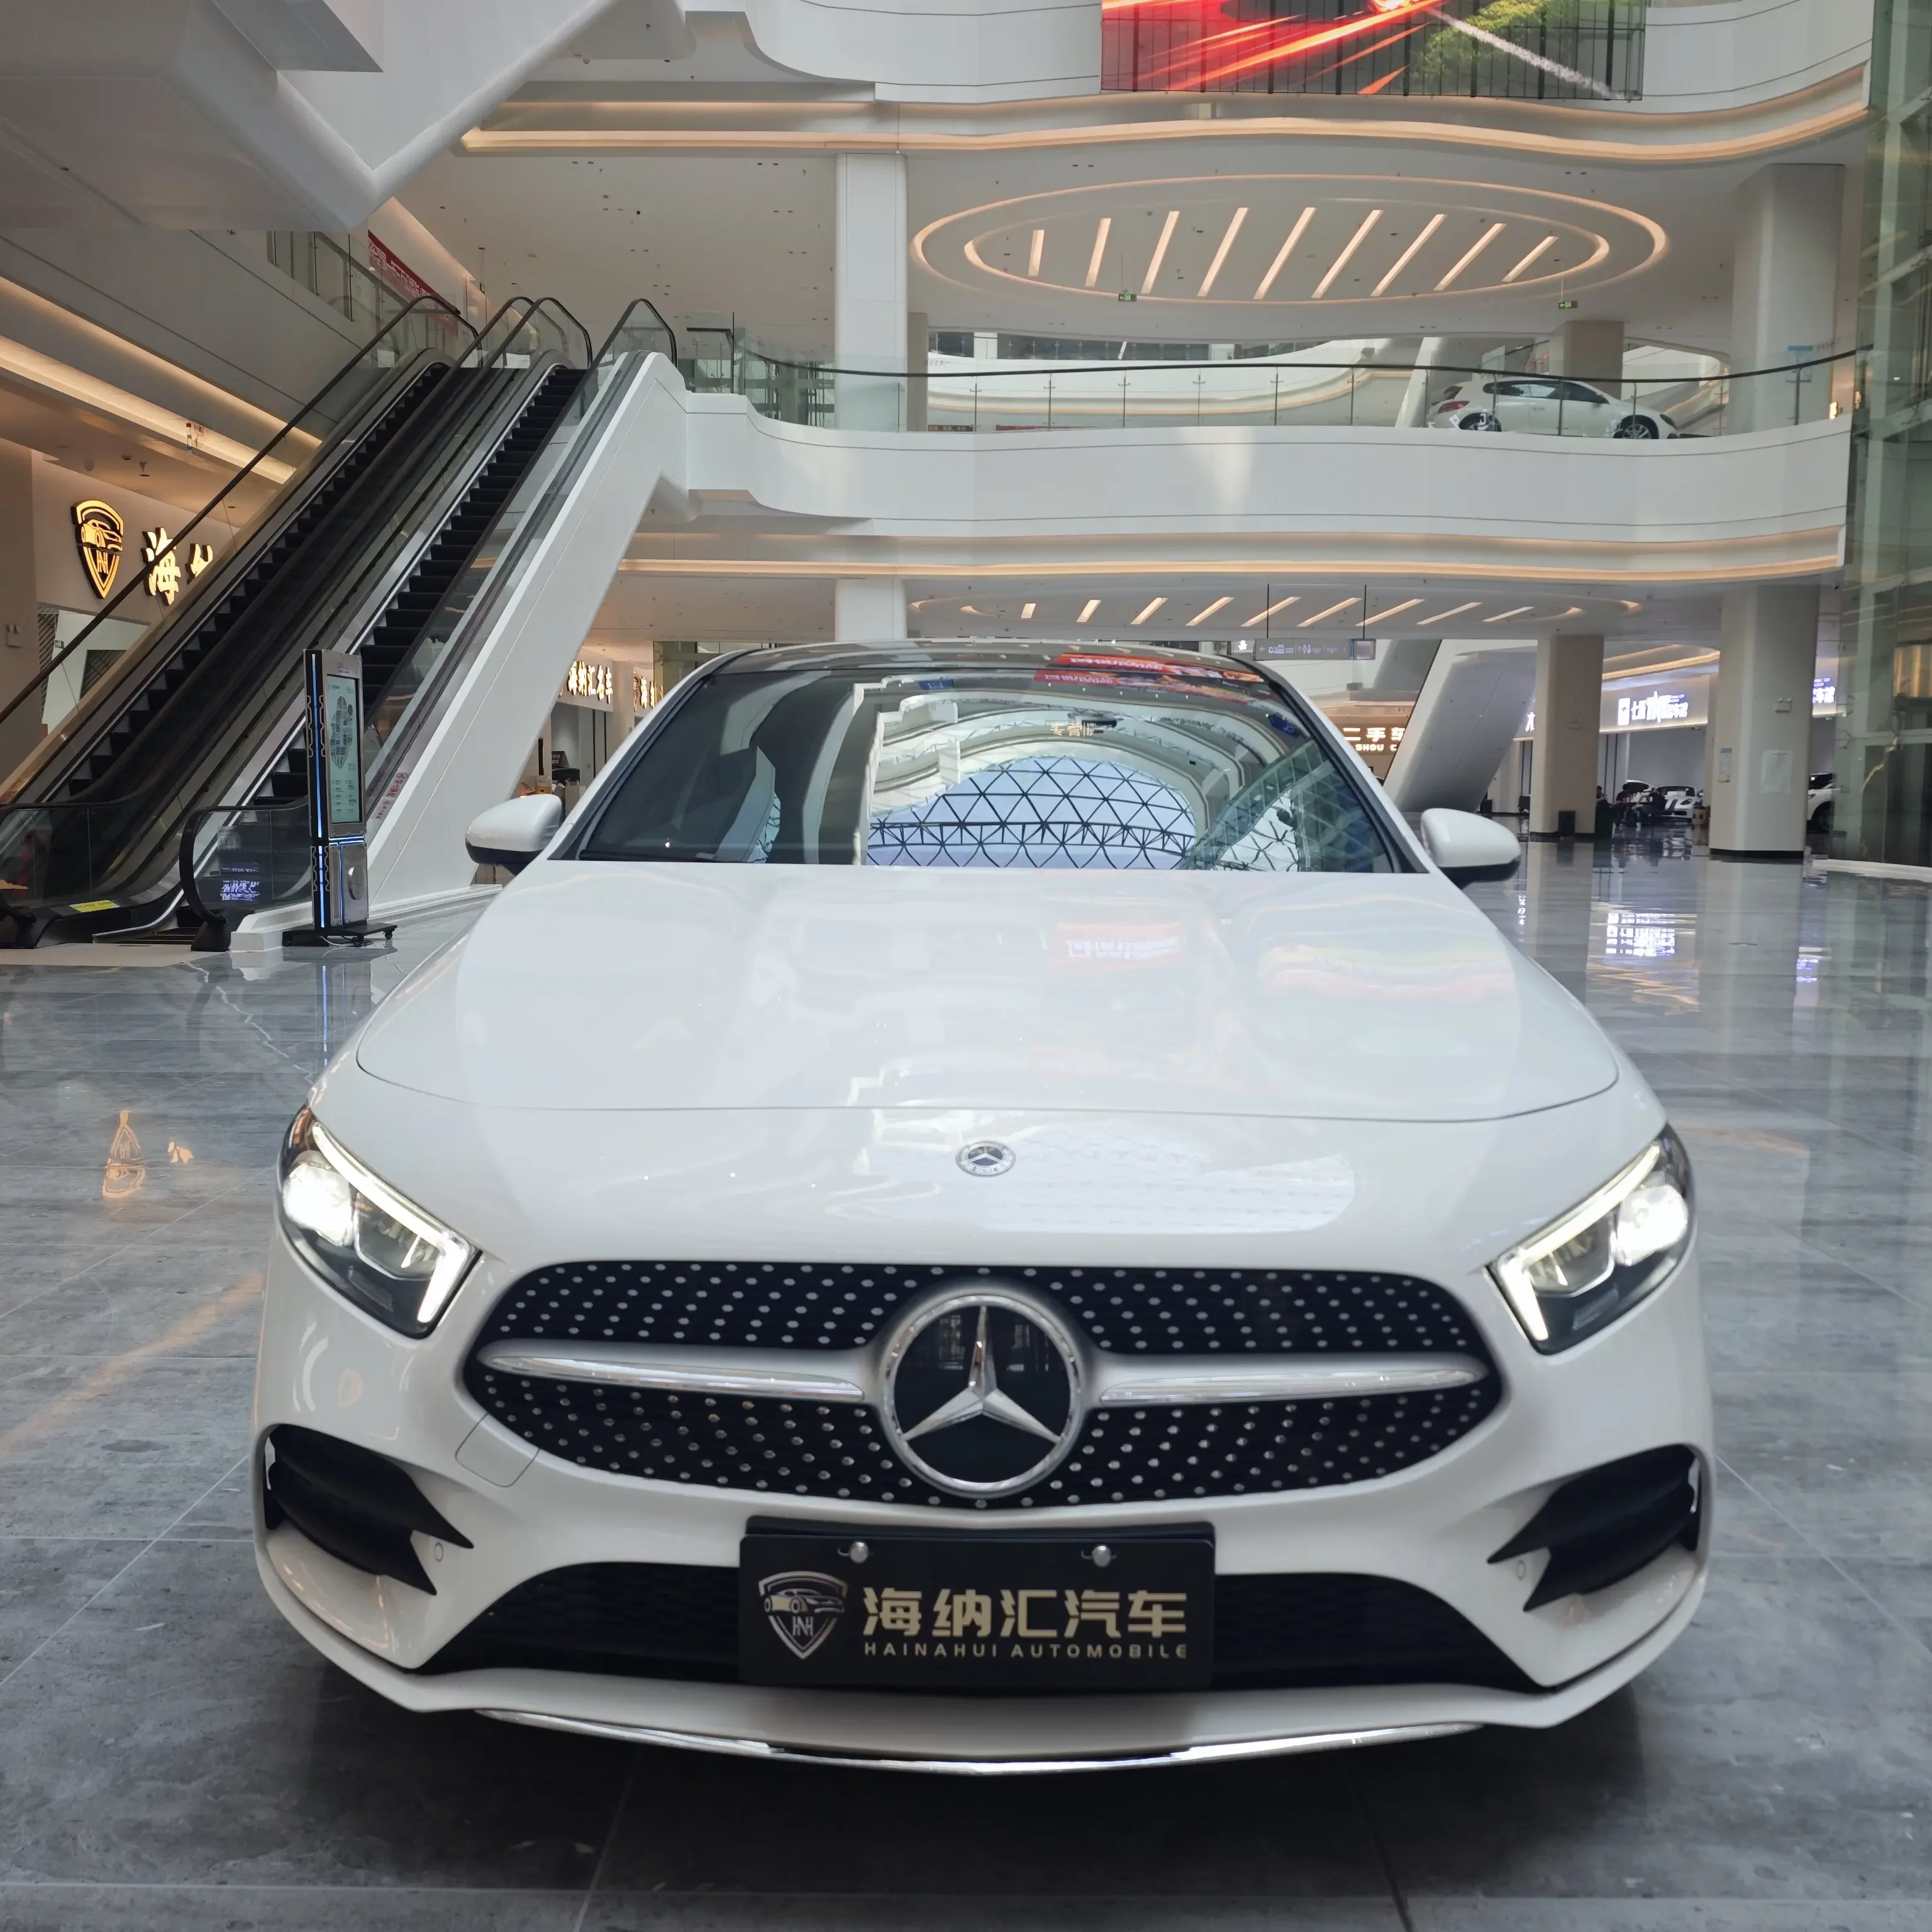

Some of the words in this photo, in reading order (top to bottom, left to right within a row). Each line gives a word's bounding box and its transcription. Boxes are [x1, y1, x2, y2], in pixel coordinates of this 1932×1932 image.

[1355, 743, 1384, 752] SHOU
[862, 1586, 1187, 1638] 海纳汇汽车
[864, 1642, 997, 1658] HAINAHUI
[1011, 1643, 1187, 1659] AUTOMOBILE
